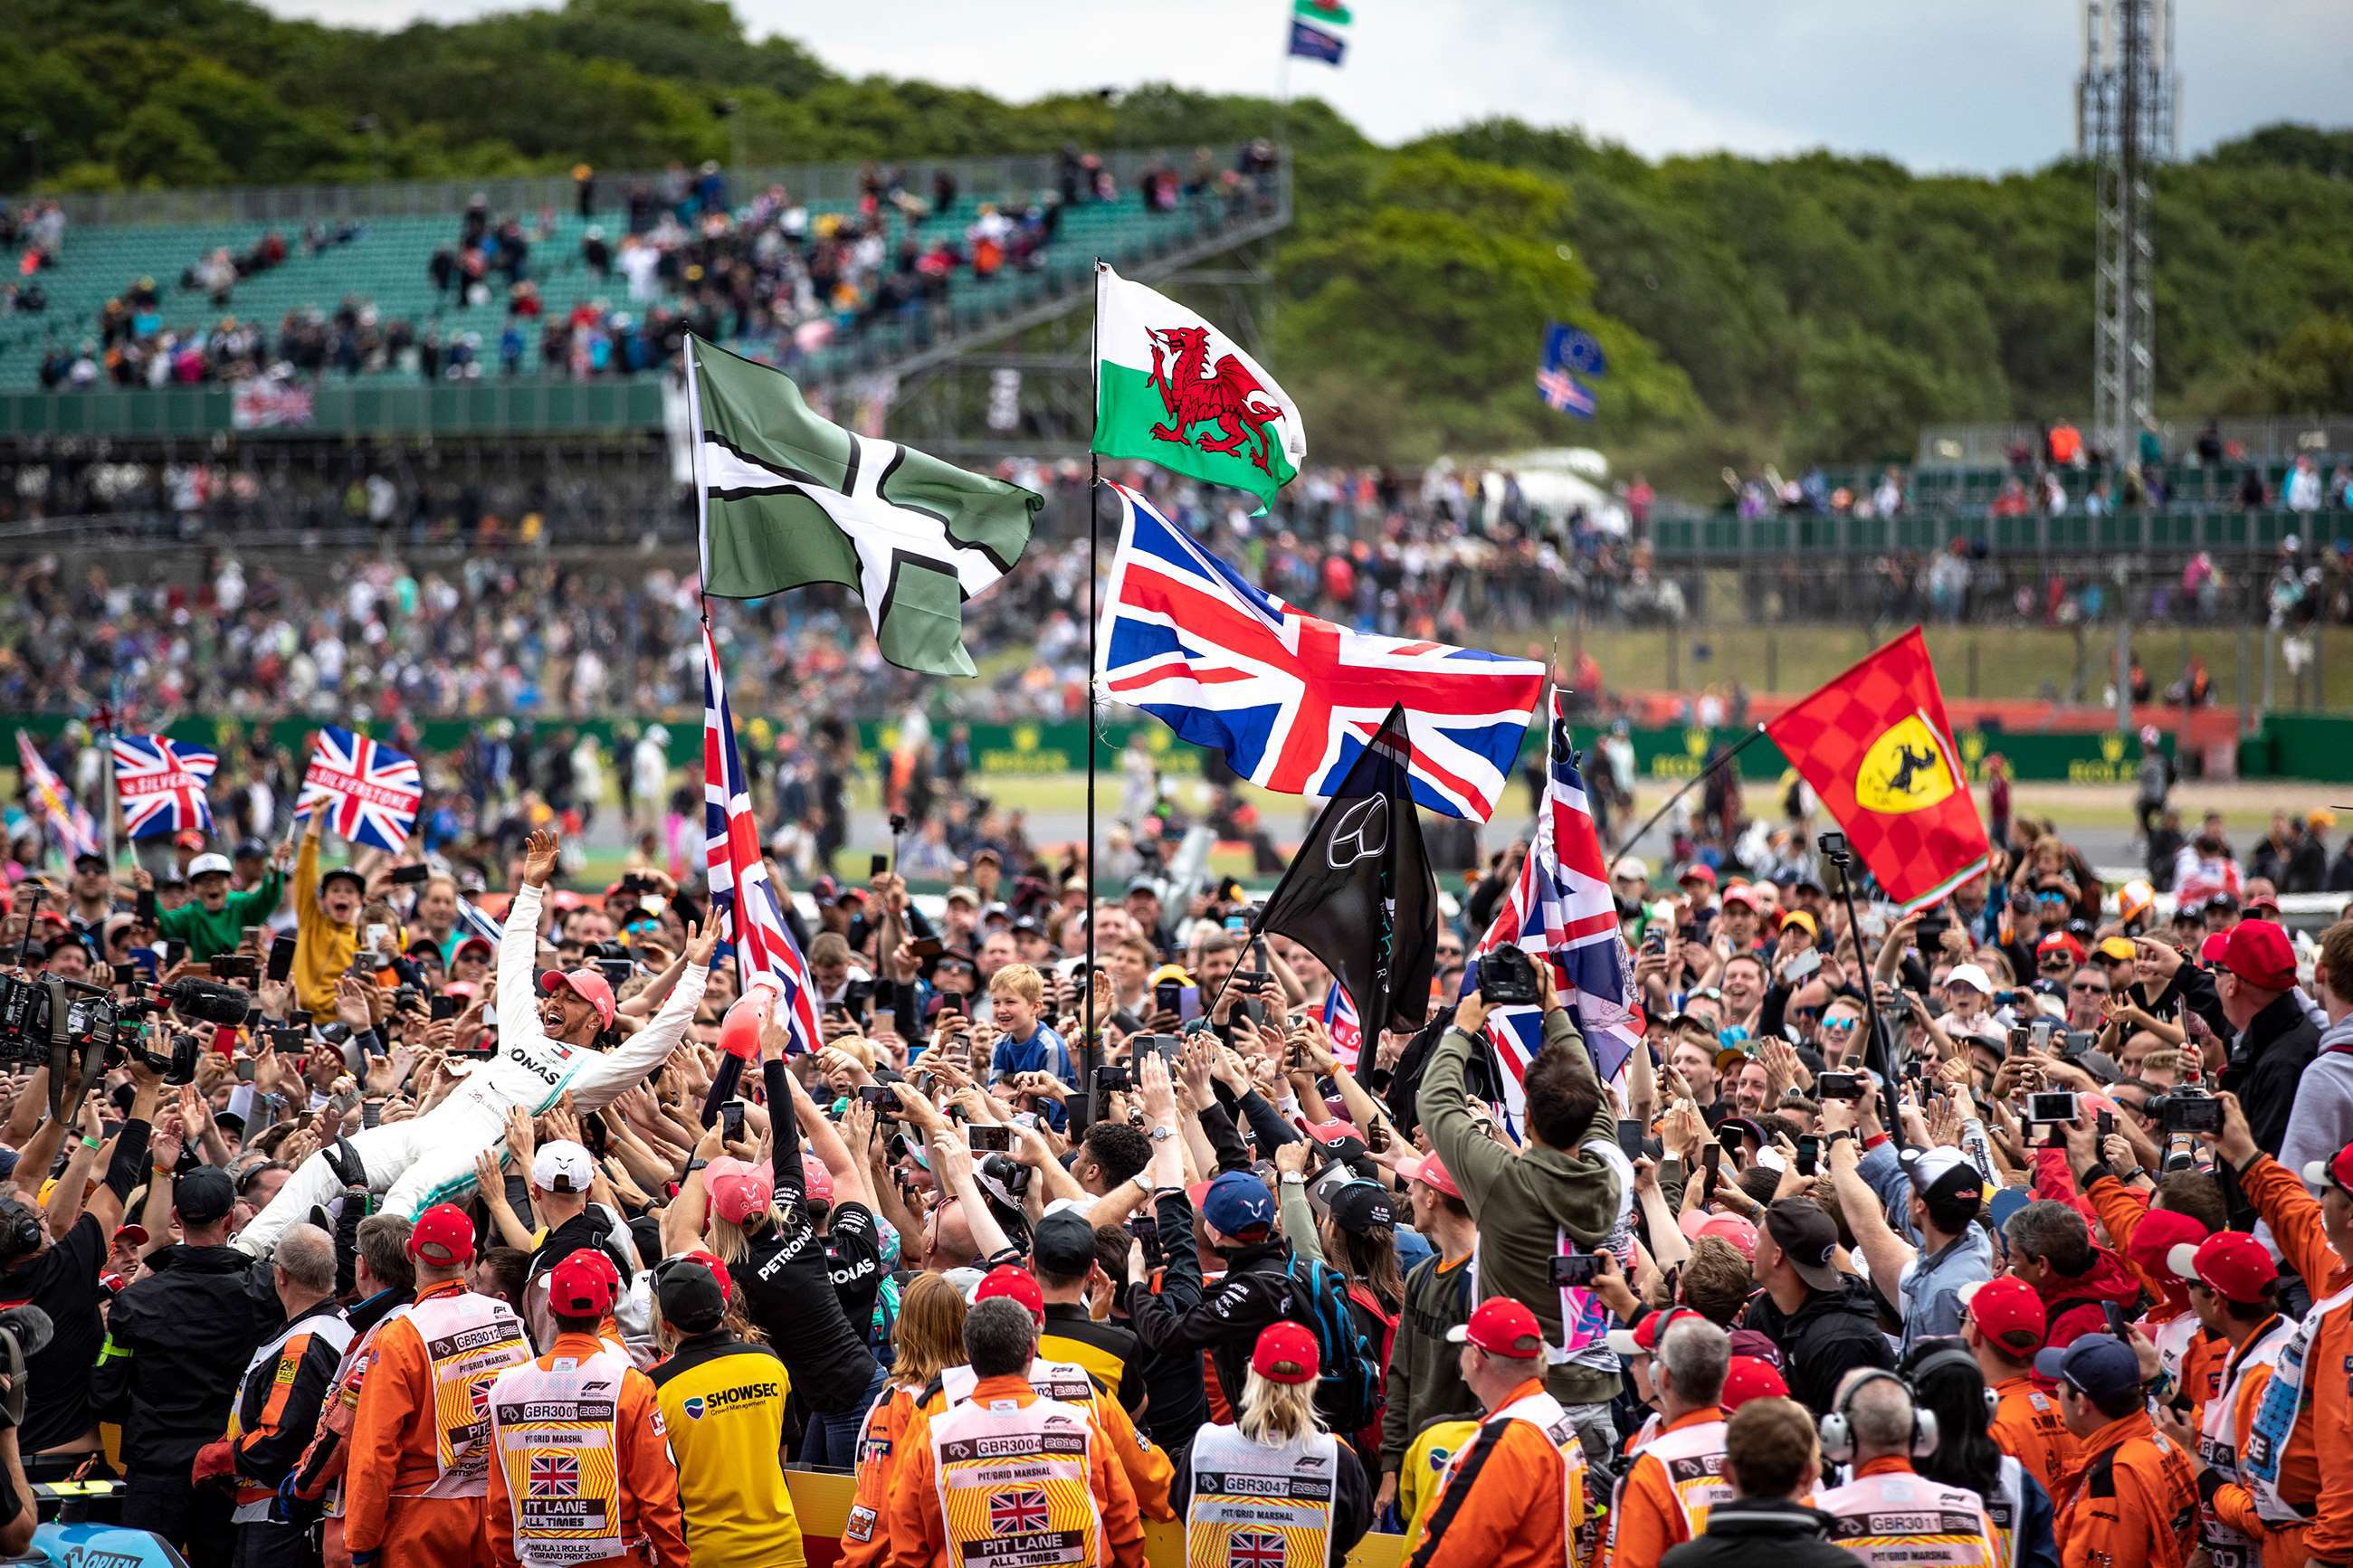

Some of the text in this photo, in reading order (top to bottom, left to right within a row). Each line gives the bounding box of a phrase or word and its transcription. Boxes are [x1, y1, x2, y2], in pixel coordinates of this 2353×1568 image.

[510, 1045, 561, 1086] ONAS
[757, 1218, 814, 1281] PETRONA
[456, 1328, 500, 1348] GBR3012
[281, 1359, 296, 1371] 24
[706, 1383, 778, 1409] SHOWSEC
[1054, 1384, 1089, 1396] 2019
[525, 1404, 611, 1418] GBR3007 2019
[710, 1400, 767, 1416] Crowd Management
[552, 1434, 584, 1444] MARSHAL
[978, 1438, 1083, 1454] GBR3004 2019
[978, 1467, 1052, 1482] PIT/GRID MARSHAL
[1225, 1477, 1330, 1496] GBR3047 2019
[545, 1500, 587, 1515] LANE
[1222, 1507, 1295, 1522] PIT/GRID MARSHAL
[548, 1516, 586, 1527] TIMES
[1872, 1517, 1940, 1531] GBR3011
[562, 1544, 590, 1553] ROLEX
[982, 1534, 1063, 1555] PIT LANE
[534, 1552, 607, 1560] GRAND PRIX 2019
[989, 1552, 1061, 1568] ALL TIMES
[1910, 1551, 1952, 1561] MARSHAL
